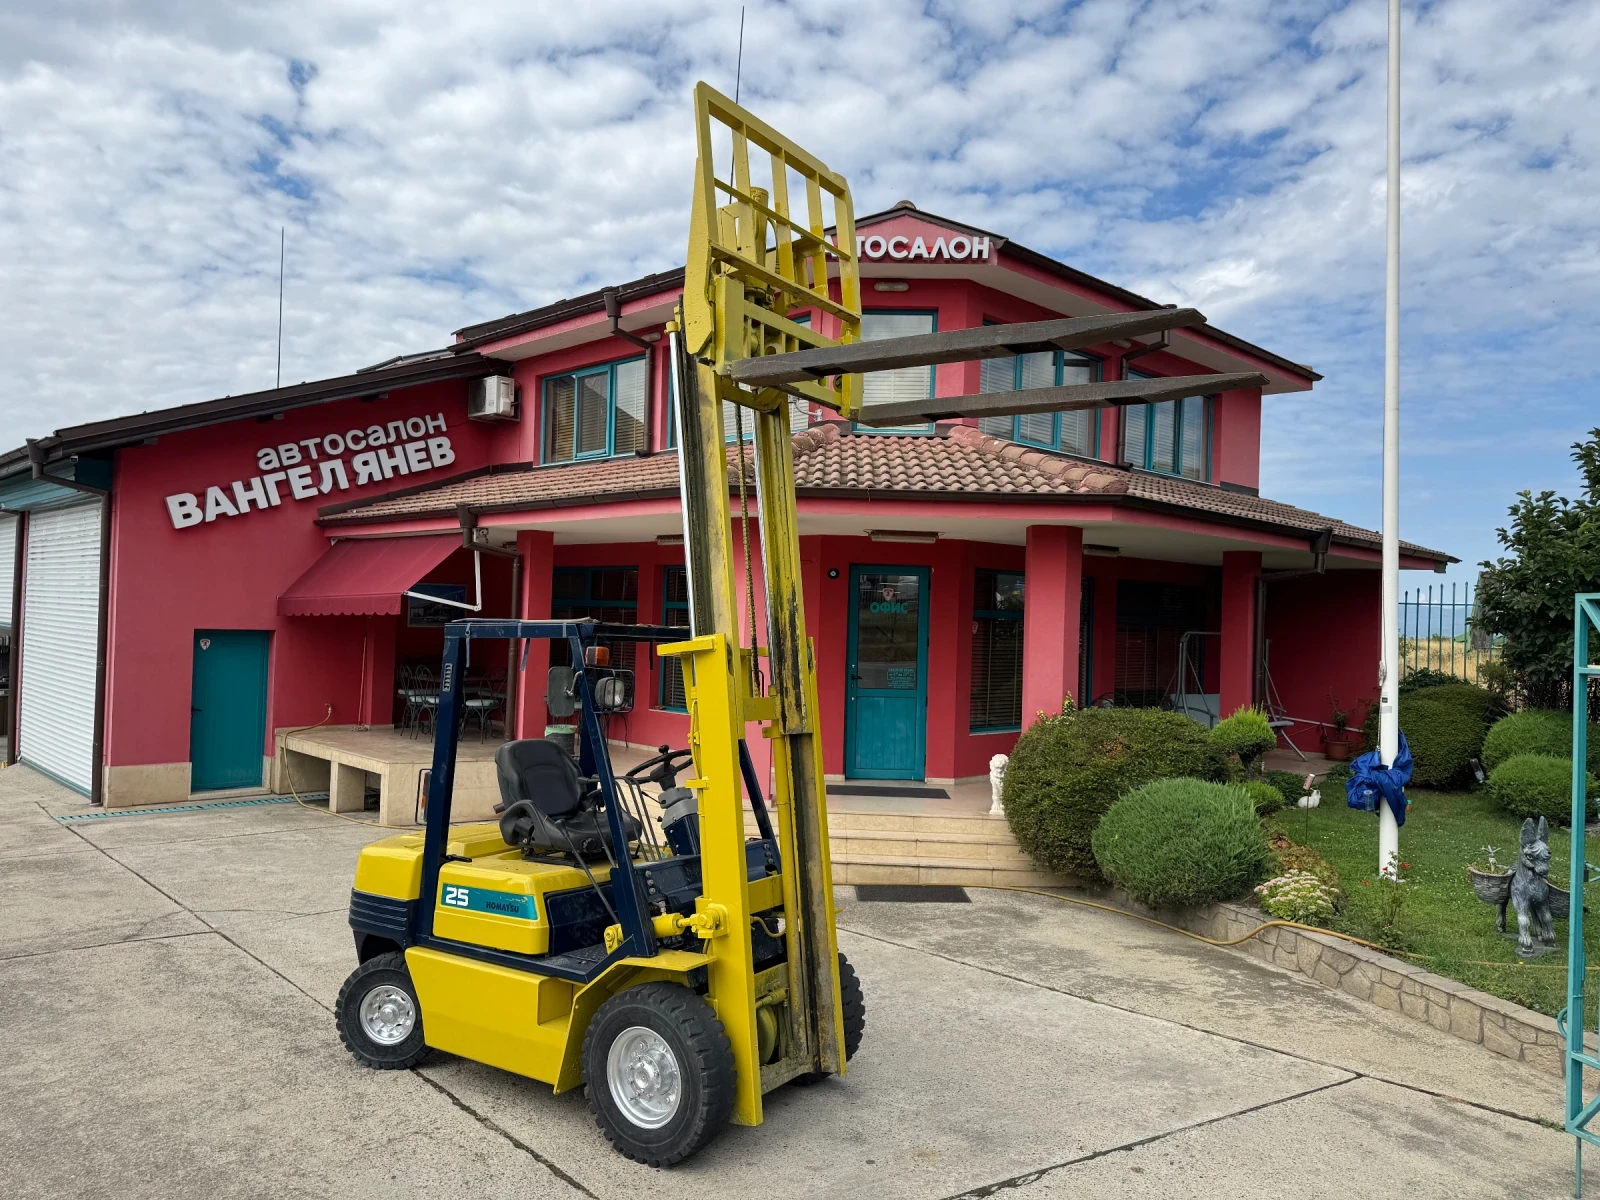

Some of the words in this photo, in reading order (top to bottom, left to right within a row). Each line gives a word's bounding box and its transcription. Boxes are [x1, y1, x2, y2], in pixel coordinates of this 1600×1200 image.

[824, 235, 989, 259] ТОСАЛОН
[257, 412, 447, 471] автосалон
[165, 458, 350, 530] ВАНГЕЛ
[352, 436, 456, 486] ЯНЕВ
[870, 601, 909, 614] ОФИС
[445, 886, 469, 907] 25
[485, 901, 519, 913] KOMATSU
